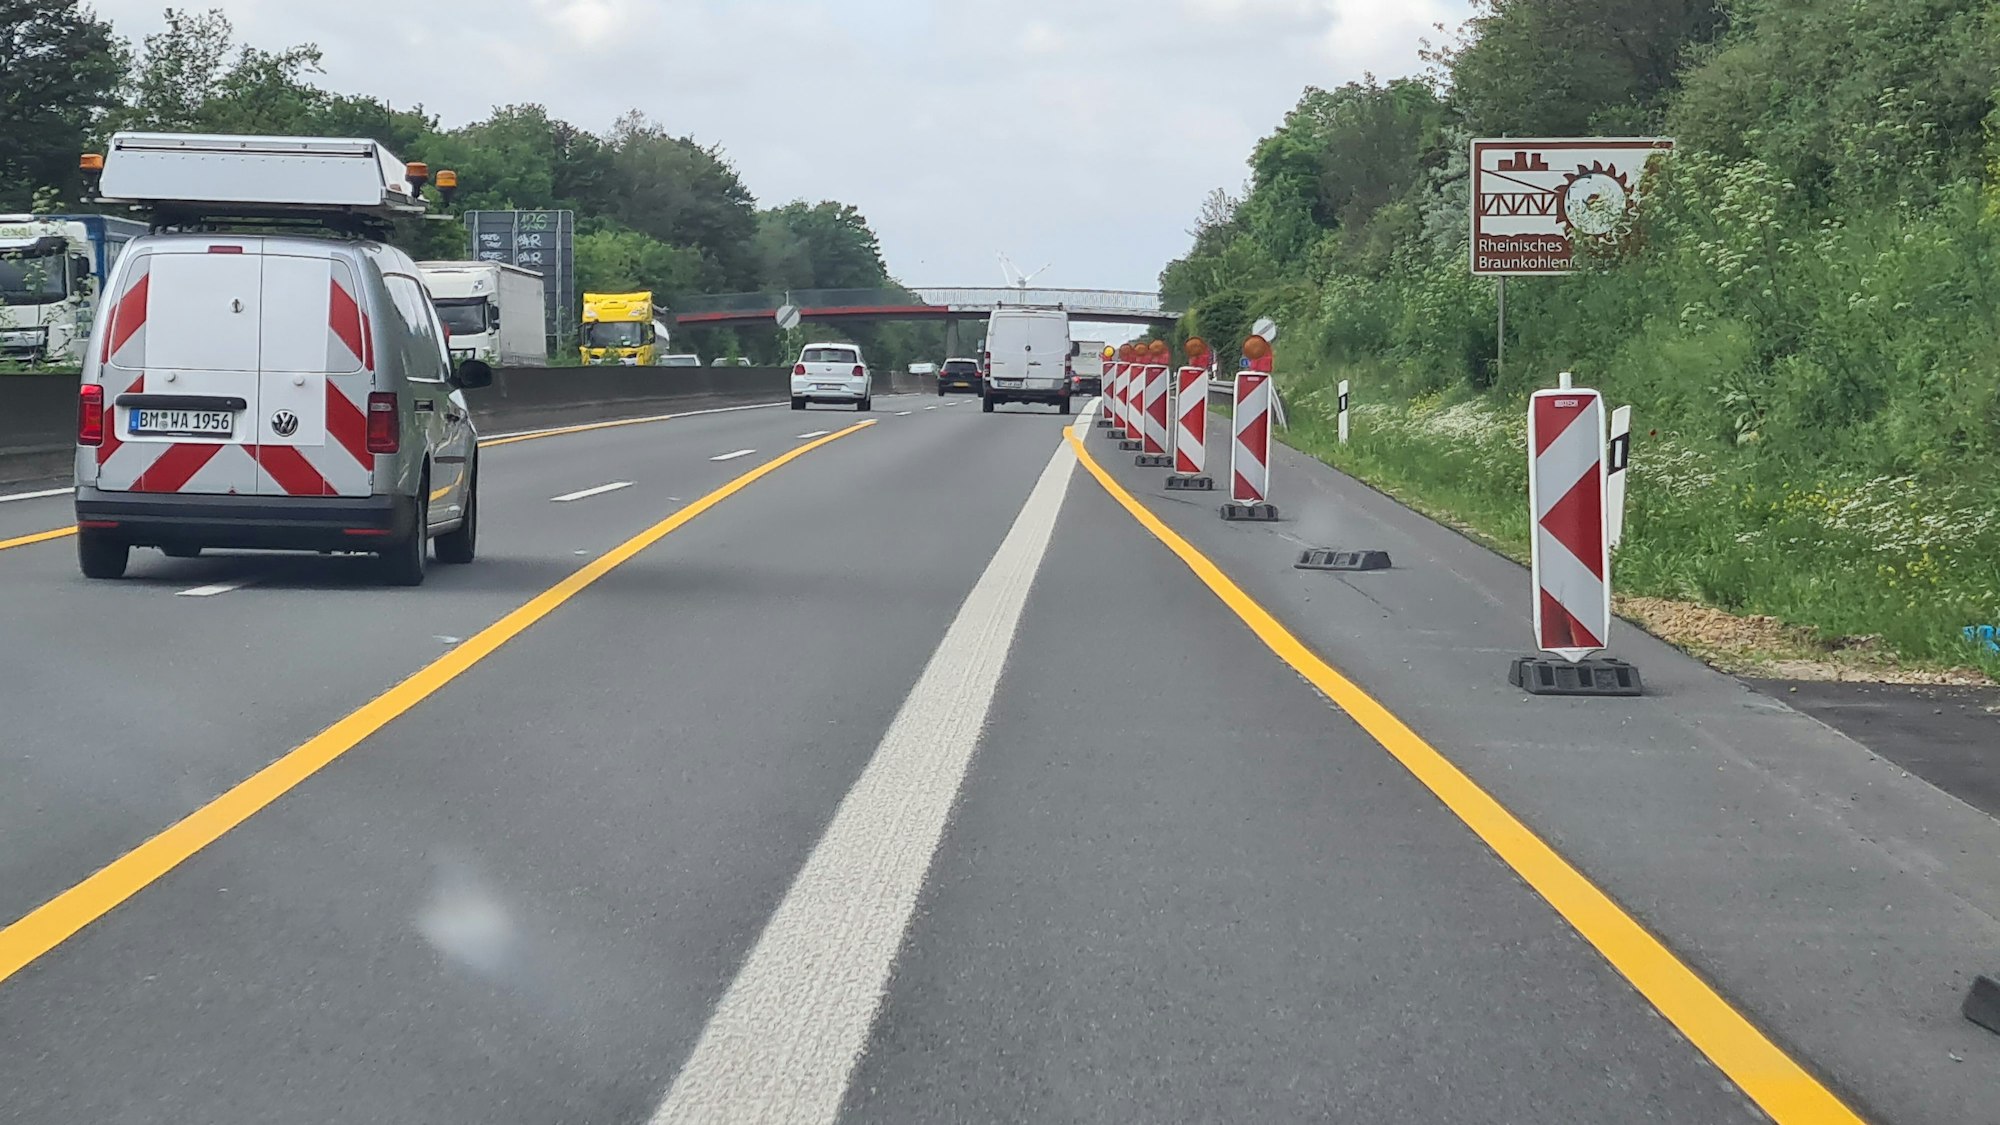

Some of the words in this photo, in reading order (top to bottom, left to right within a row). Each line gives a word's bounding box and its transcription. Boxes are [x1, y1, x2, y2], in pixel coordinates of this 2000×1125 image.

[0, 224, 33, 237] exal
[1479, 239, 1563, 252] Rheinisches
[139, 412, 159, 428] BM
[171, 412, 188, 428] WA
[192, 414, 229, 429] 1956
